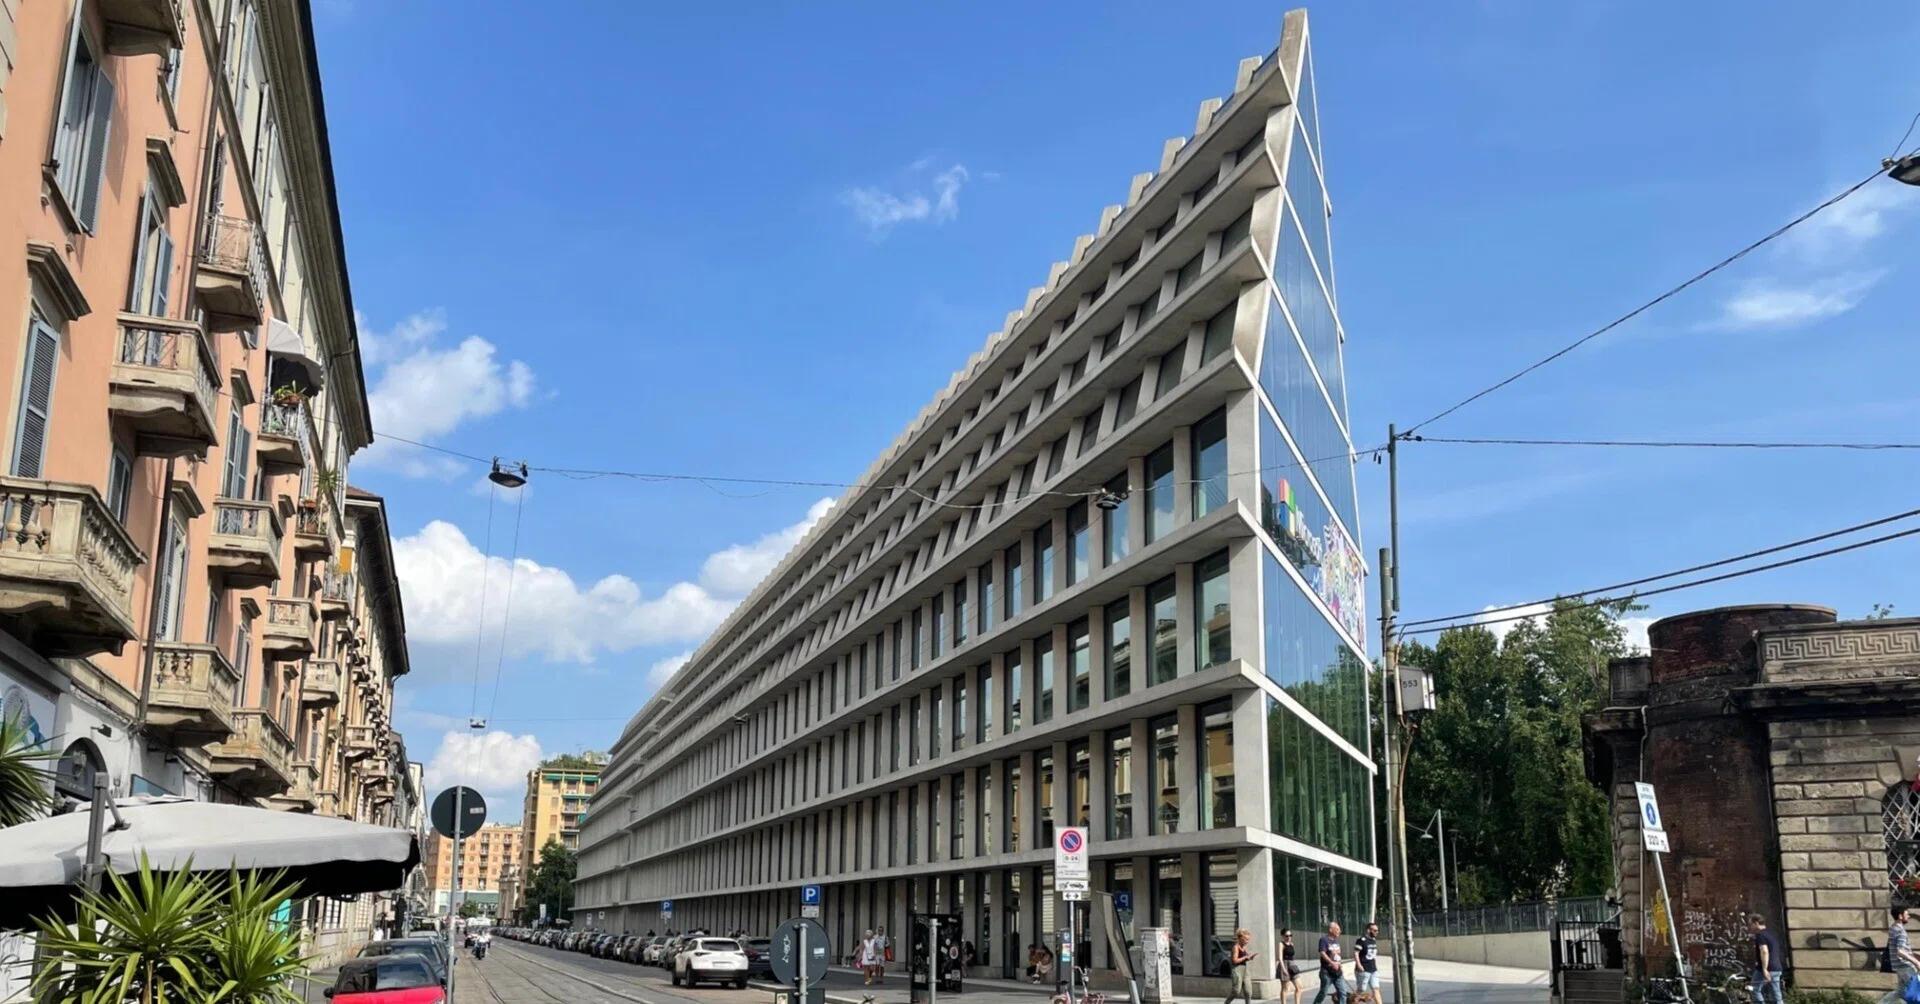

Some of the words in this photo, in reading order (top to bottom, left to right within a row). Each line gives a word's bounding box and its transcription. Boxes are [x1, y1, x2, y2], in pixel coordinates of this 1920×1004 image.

[1402, 679, 1418, 688] 553
[805, 888, 816, 901] P
[663, 901, 670, 910] P
